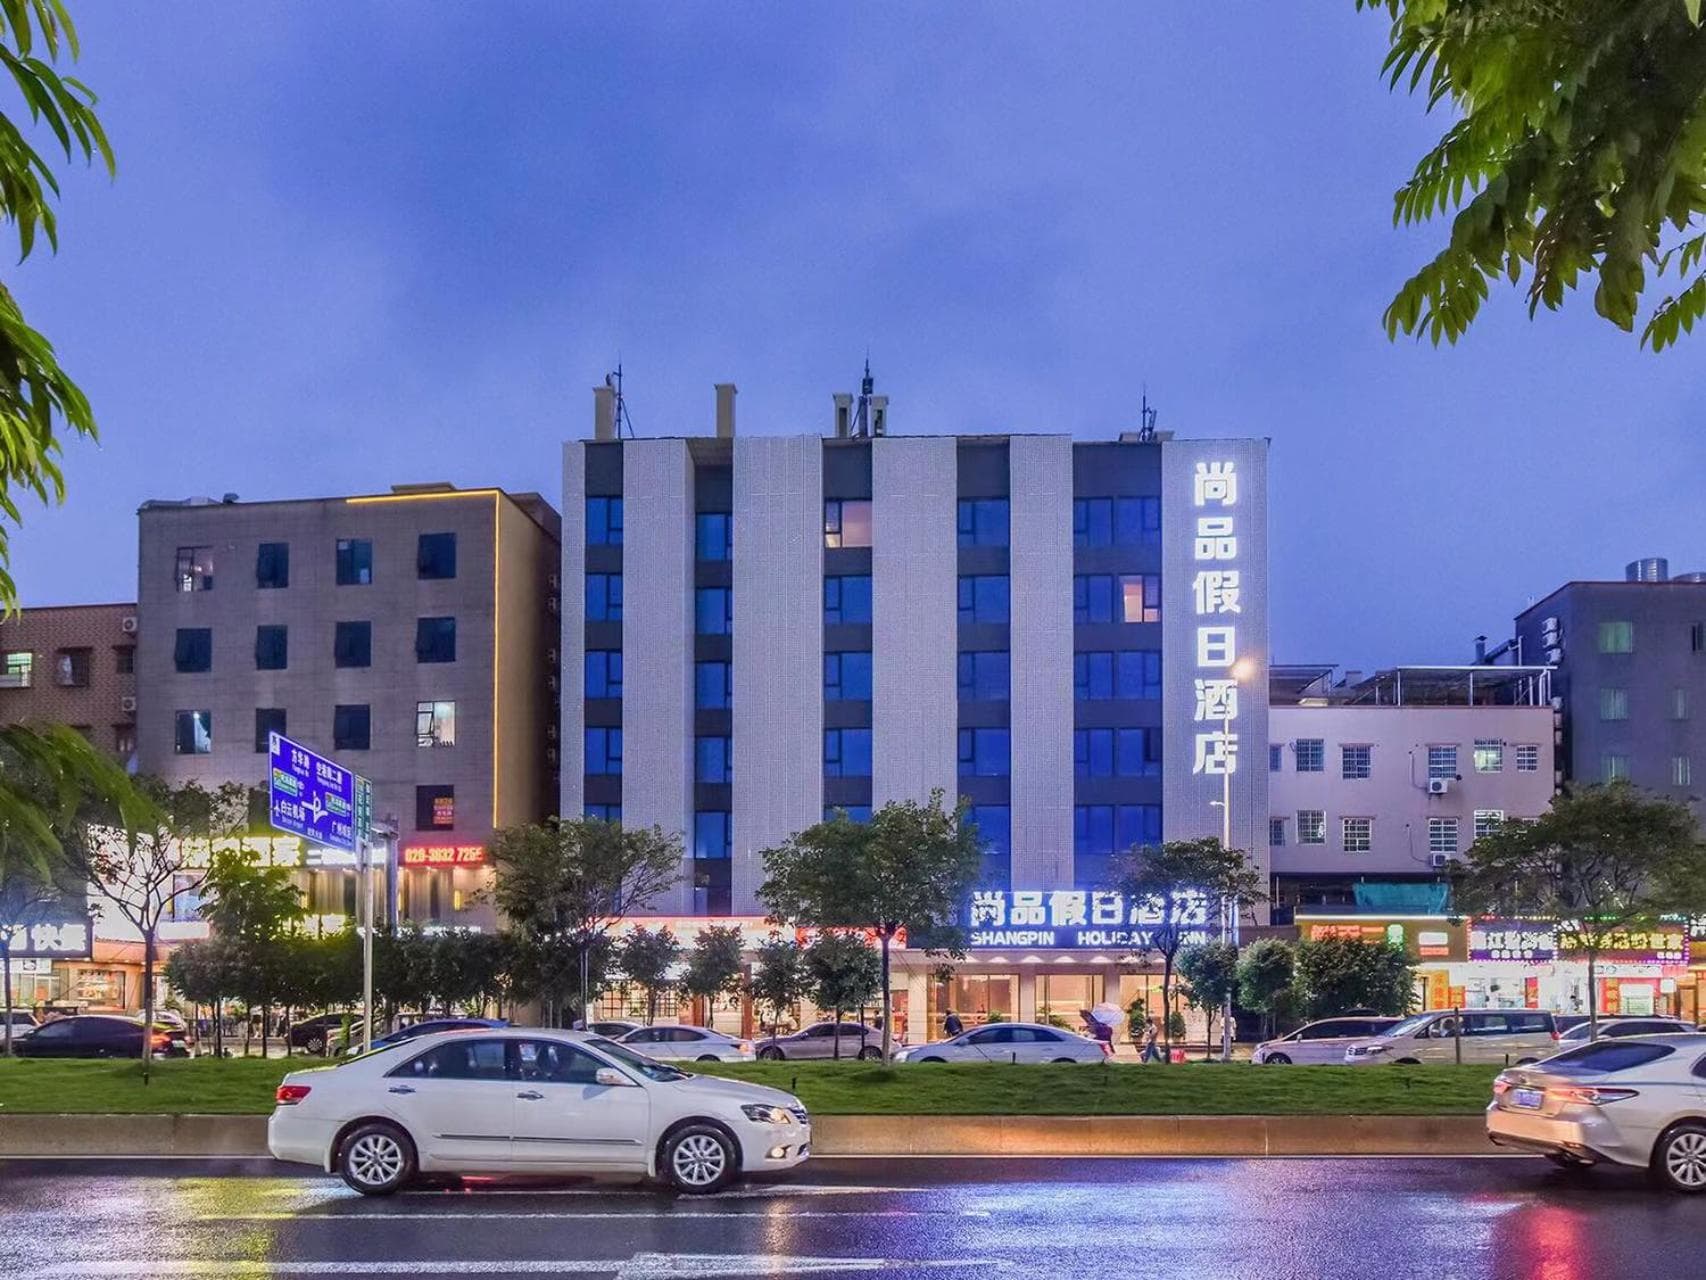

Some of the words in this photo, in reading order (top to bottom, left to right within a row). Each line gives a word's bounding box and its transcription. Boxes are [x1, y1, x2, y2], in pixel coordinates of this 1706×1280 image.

[1193, 462, 1241, 775] 尚品假日酒店
[970, 891, 1207, 926] 尚品假日酒店
[970, 931, 1055, 945] SHANGPIN
[1077, 931, 1153, 945] HOLIDAY
